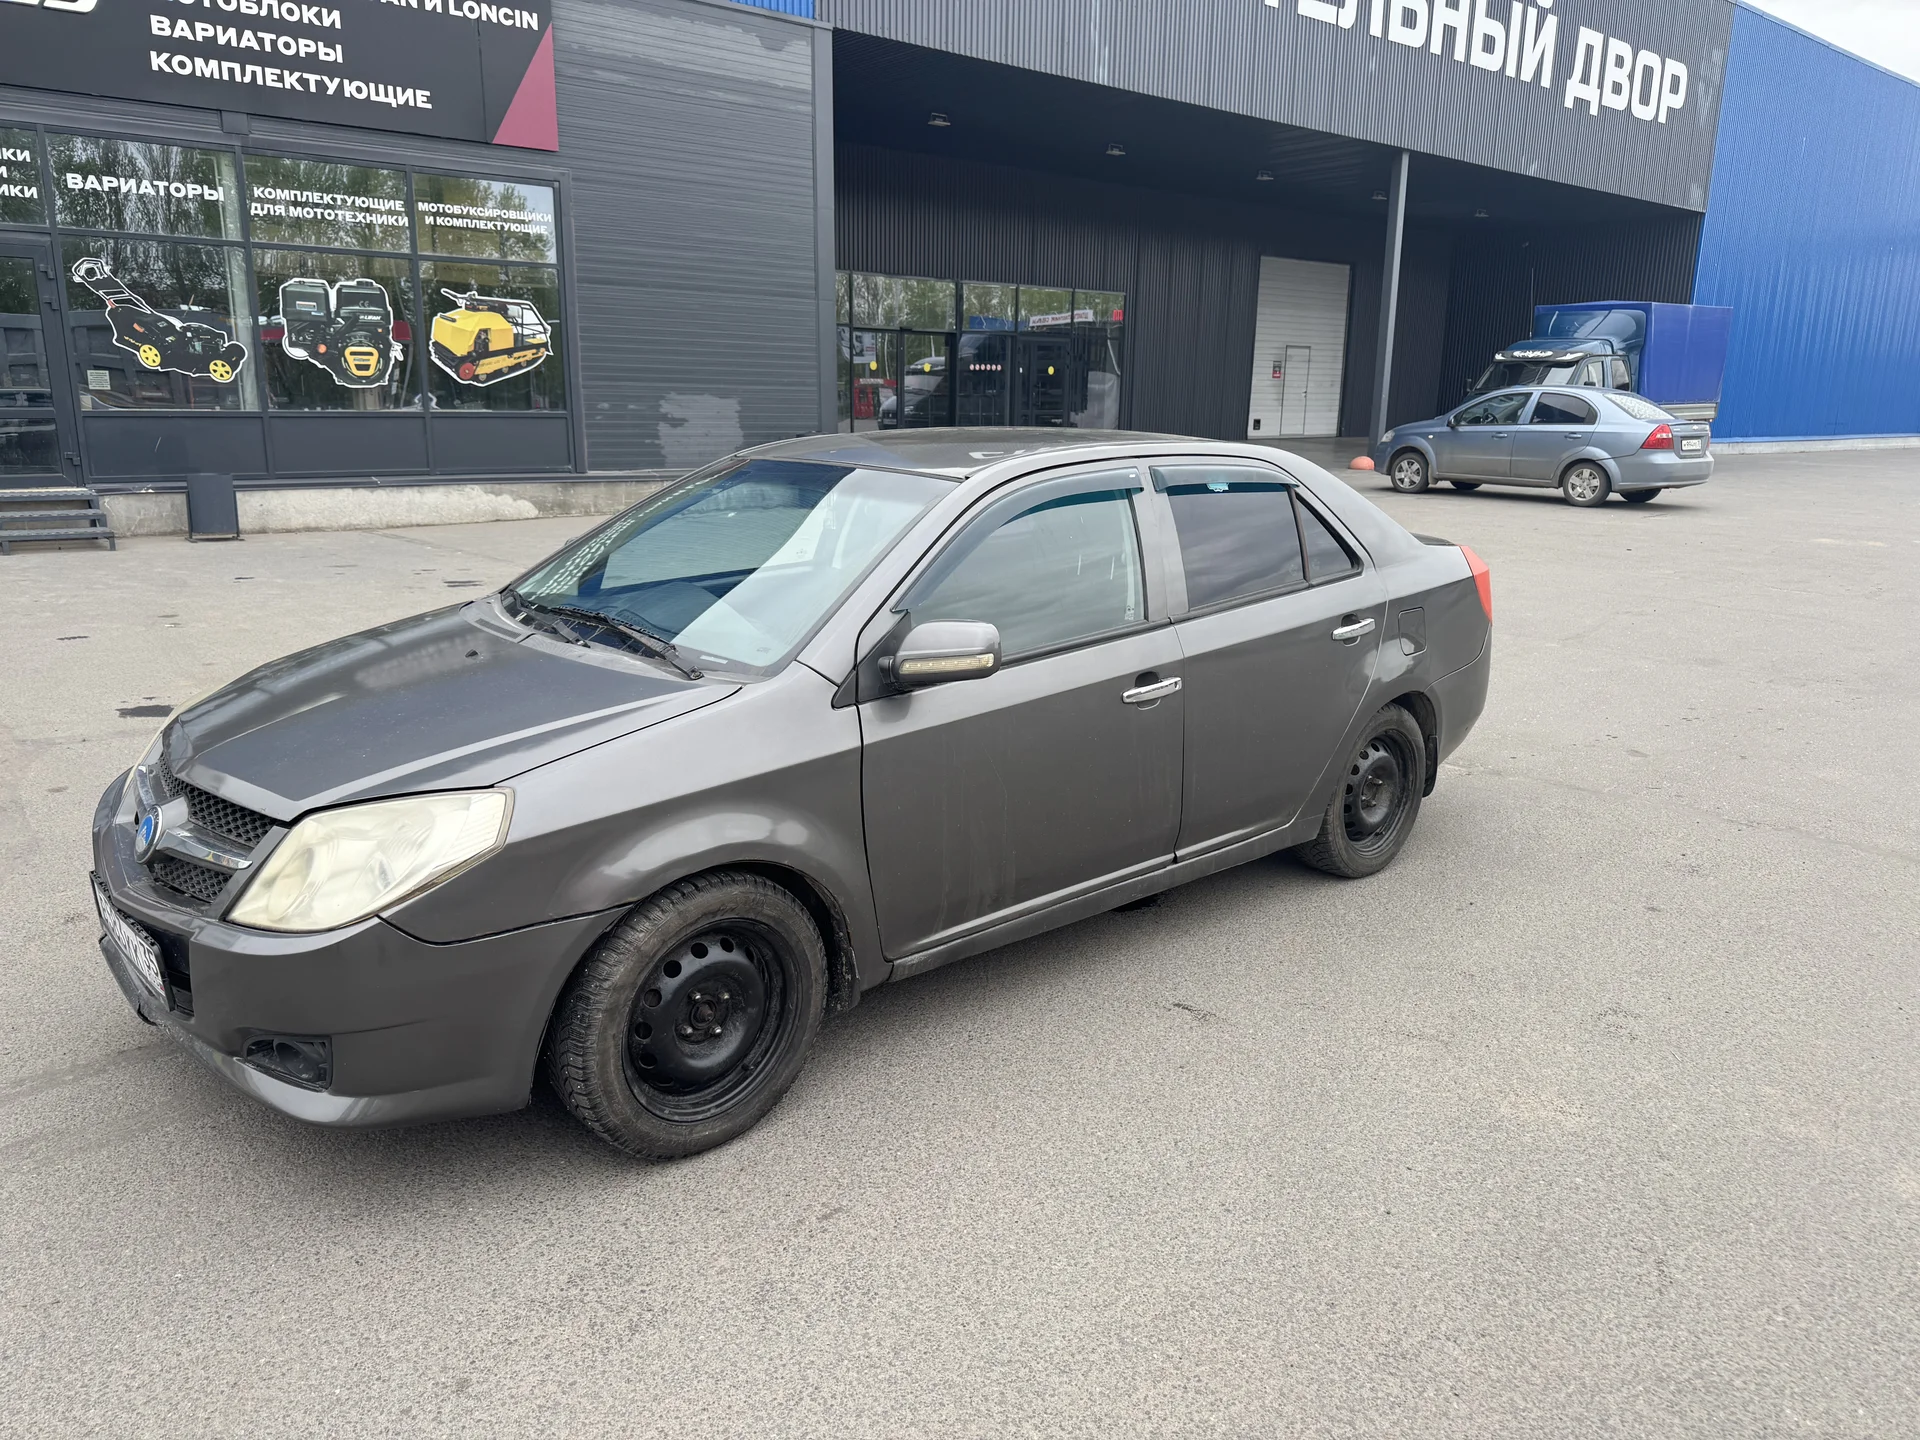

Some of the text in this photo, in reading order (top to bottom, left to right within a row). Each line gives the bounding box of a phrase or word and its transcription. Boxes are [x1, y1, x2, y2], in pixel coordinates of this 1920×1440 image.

[167, 0, 342, 30] ОБЛОКИ
[449, 0, 539, 31] LONCIN
[150, 14, 344, 64] ВАРИАТОРЫ
[149, 50, 433, 110] КОМПЛЕКТУЮЩИЕ
[1564, 26, 1688, 124] ДВОР
[0, 147, 31, 163] КИ
[66, 172, 225, 202] ВАРИАТОРЫ
[253, 186, 405, 212] КОМПЛЕКТУЮЩИЕ
[250, 202, 409, 227] ДЛЯ МОТОТЕХНИКИ
[417, 201, 552, 223] МОТОБУКСИРОВЩИКИ
[424, 215, 548, 235] И КОМПЛЕКТУЮЩИЕ
